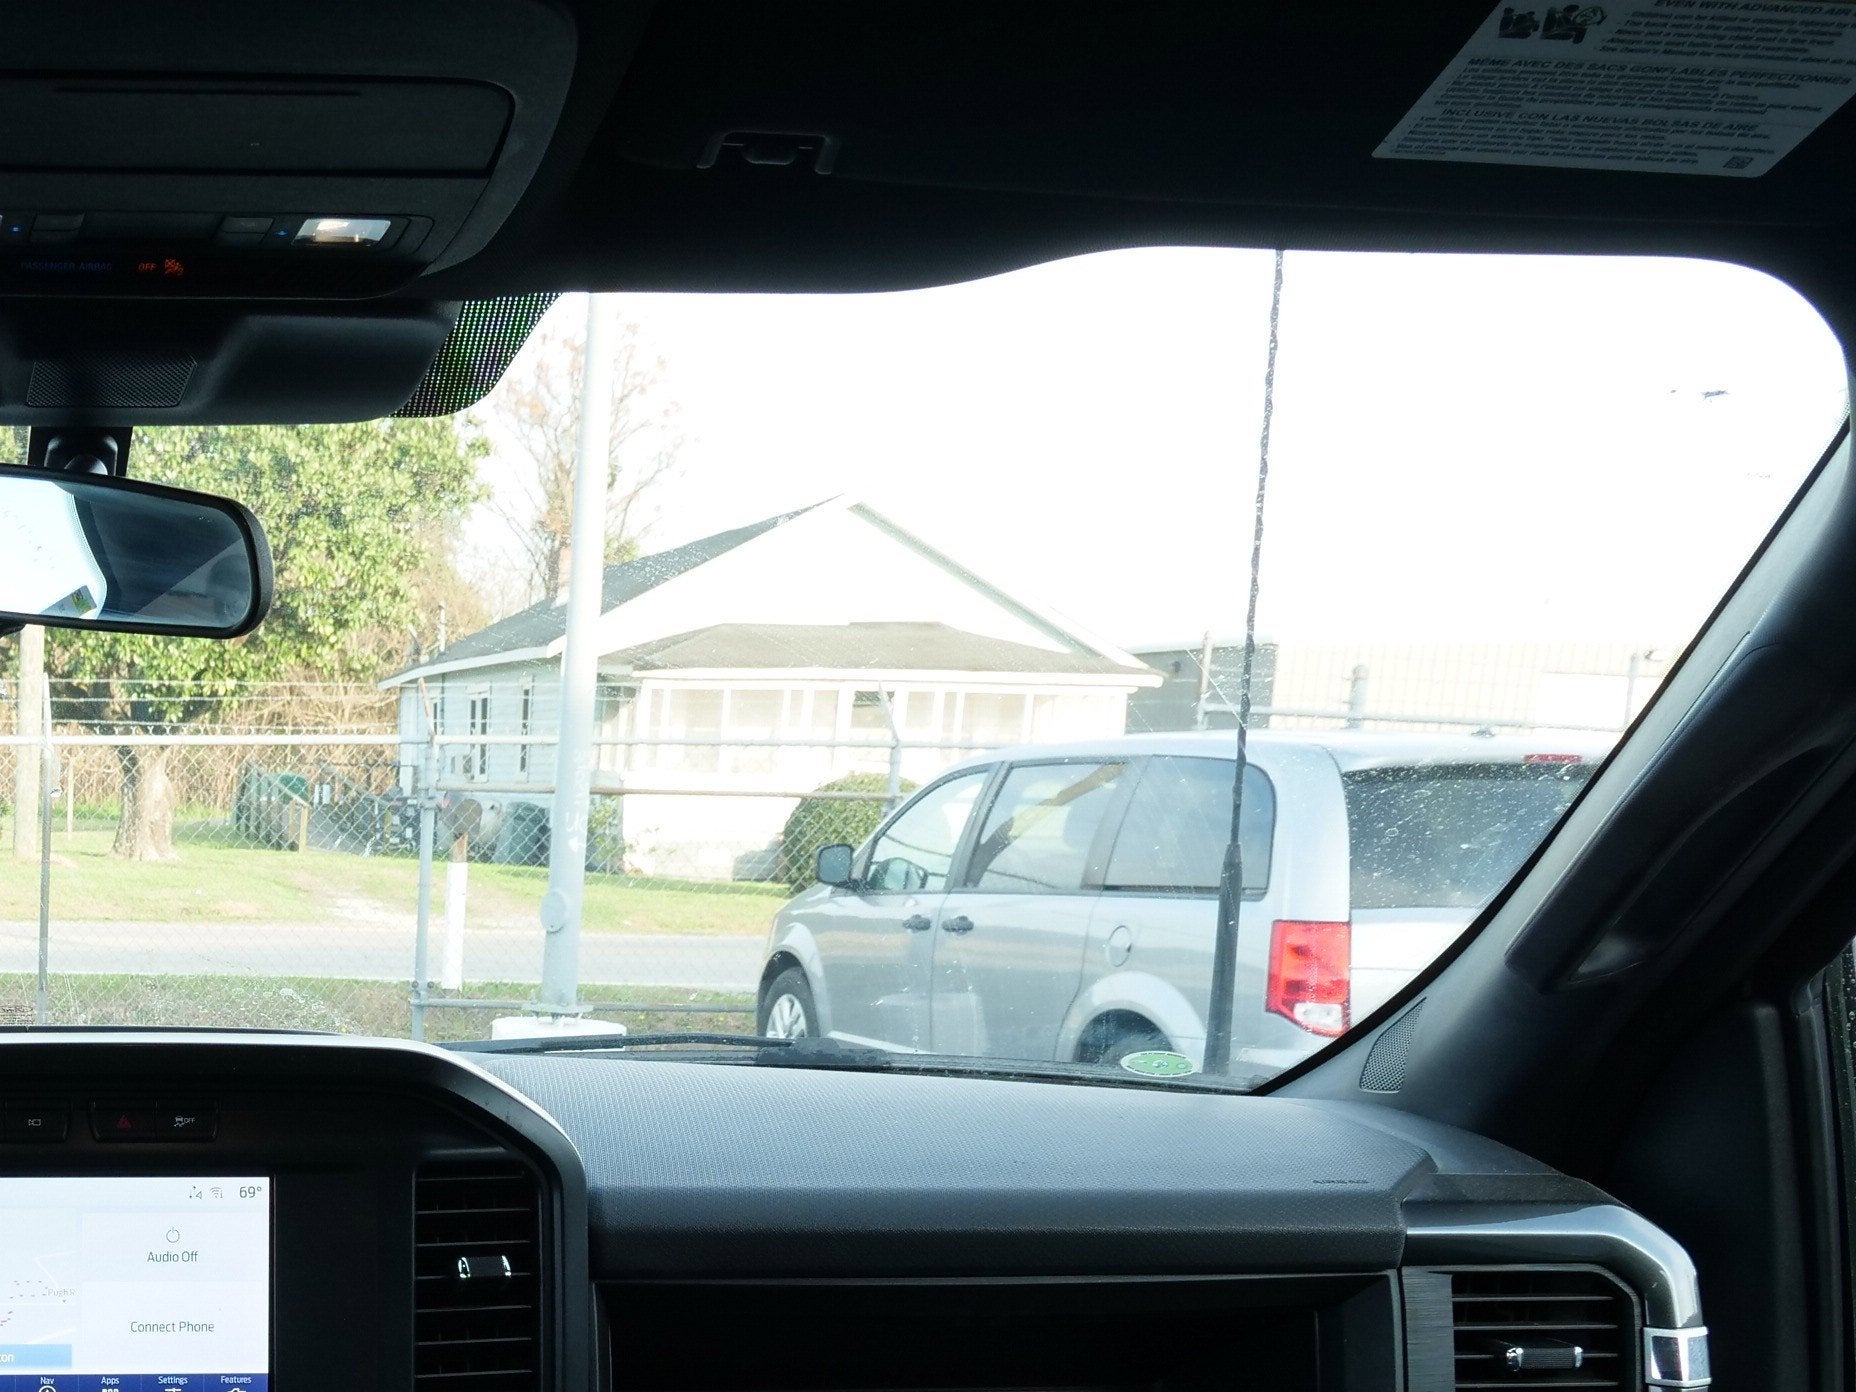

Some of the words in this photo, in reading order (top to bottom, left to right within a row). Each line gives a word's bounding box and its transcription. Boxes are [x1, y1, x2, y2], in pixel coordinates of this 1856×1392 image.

[138, 262, 156, 271] OFF
[147, 1250, 179, 1263] Audio
[181, 1250, 199, 1263] Off
[130, 1320, 176, 1333] Connect
[178, 1320, 215, 1333] Phone
[40, 1376, 55, 1386] Nav
[101, 1376, 120, 1388] Apps
[158, 1375, 188, 1388] Settings
[220, 1374, 252, 1386] Features
